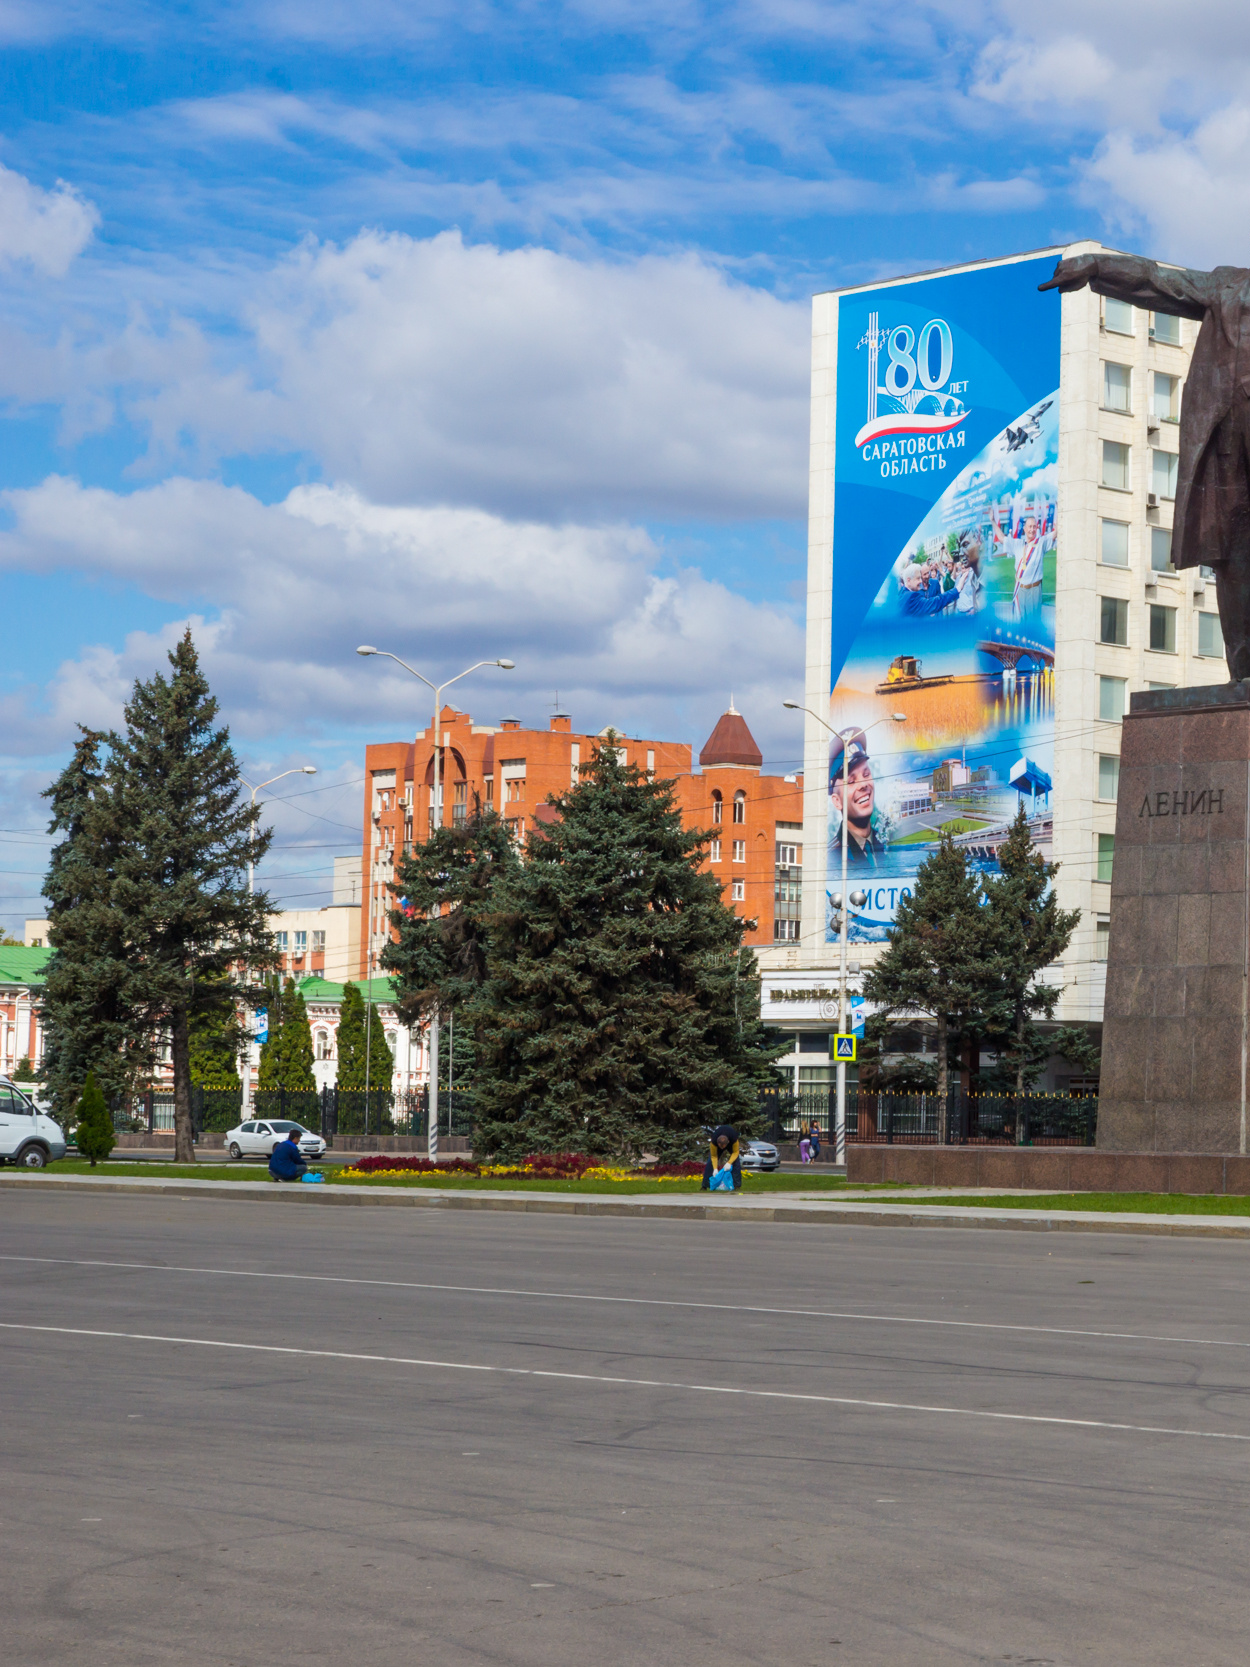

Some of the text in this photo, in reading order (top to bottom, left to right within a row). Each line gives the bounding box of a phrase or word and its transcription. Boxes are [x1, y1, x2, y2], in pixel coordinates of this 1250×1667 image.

[948, 380, 969, 395] ЛЕТ
[862, 430, 966, 462] САРАТОВСКАЯ
[880, 453, 947, 478] ОБЛАСТЬ
[1138, 788, 1225, 818] ЛЕНИН
[861, 886, 912, 911] ИСТО
